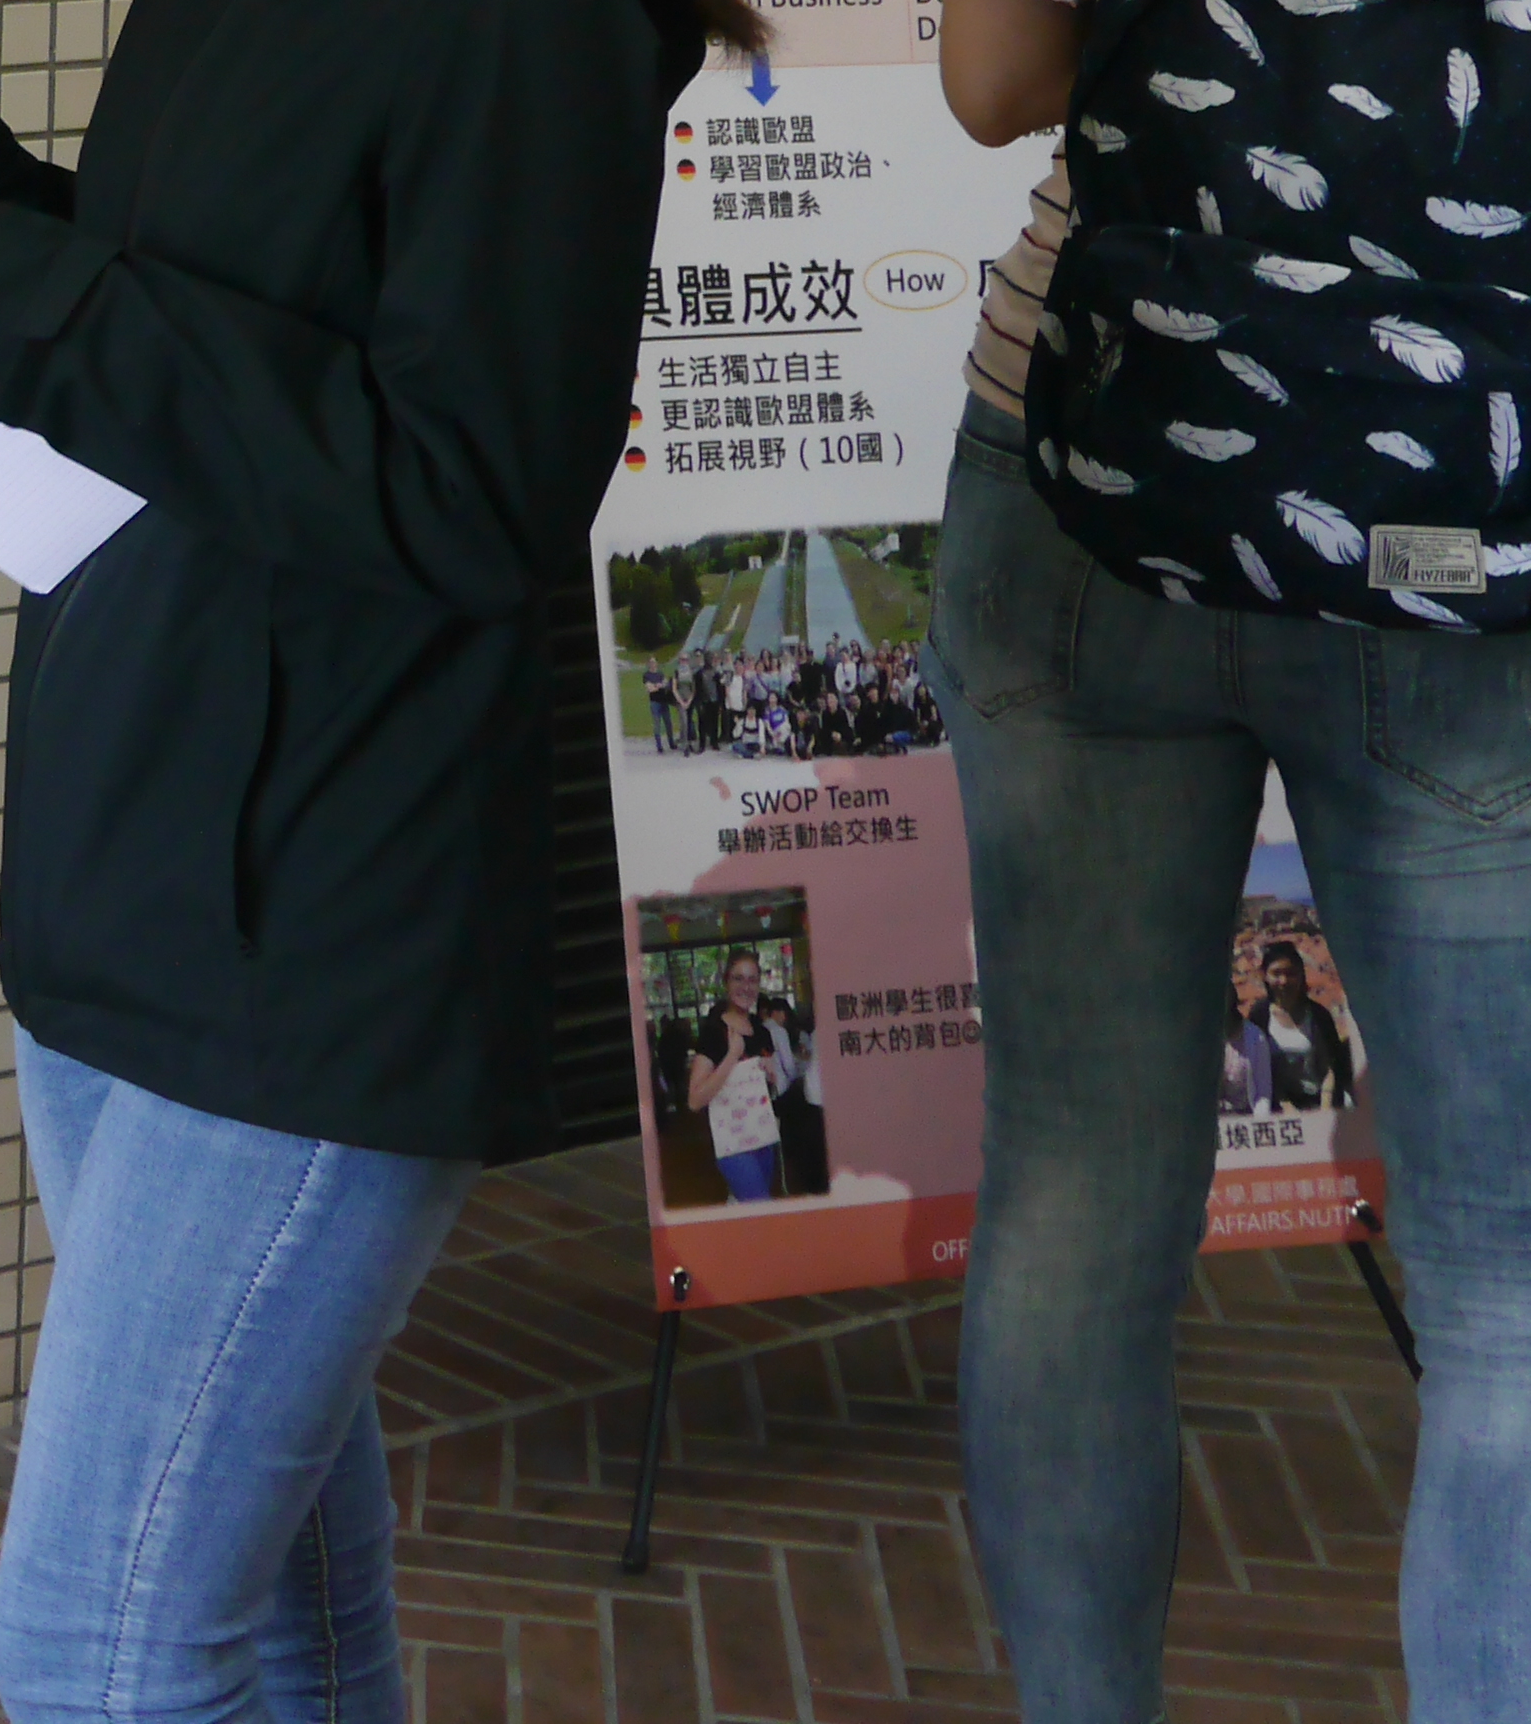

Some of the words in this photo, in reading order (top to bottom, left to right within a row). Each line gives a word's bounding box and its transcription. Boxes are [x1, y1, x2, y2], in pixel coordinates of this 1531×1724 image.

[707, 116, 815, 146] 認識歐盟
[713, 190, 821, 221] 經濟體系
[643, 259, 858, 328] 具體成效
[886, 268, 945, 293] How
[658, 351, 842, 388] 生活獨立自主
[661, 392, 875, 431] 更認識歐盟體系
[741, 787, 818, 816] SWOP
[826, 786, 889, 810] Team
[718, 814, 919, 855] 舉辦活動給交換生
[1218, 1119, 1305, 1150] 埃西亞
[932, 1238, 968, 1262] OFF
